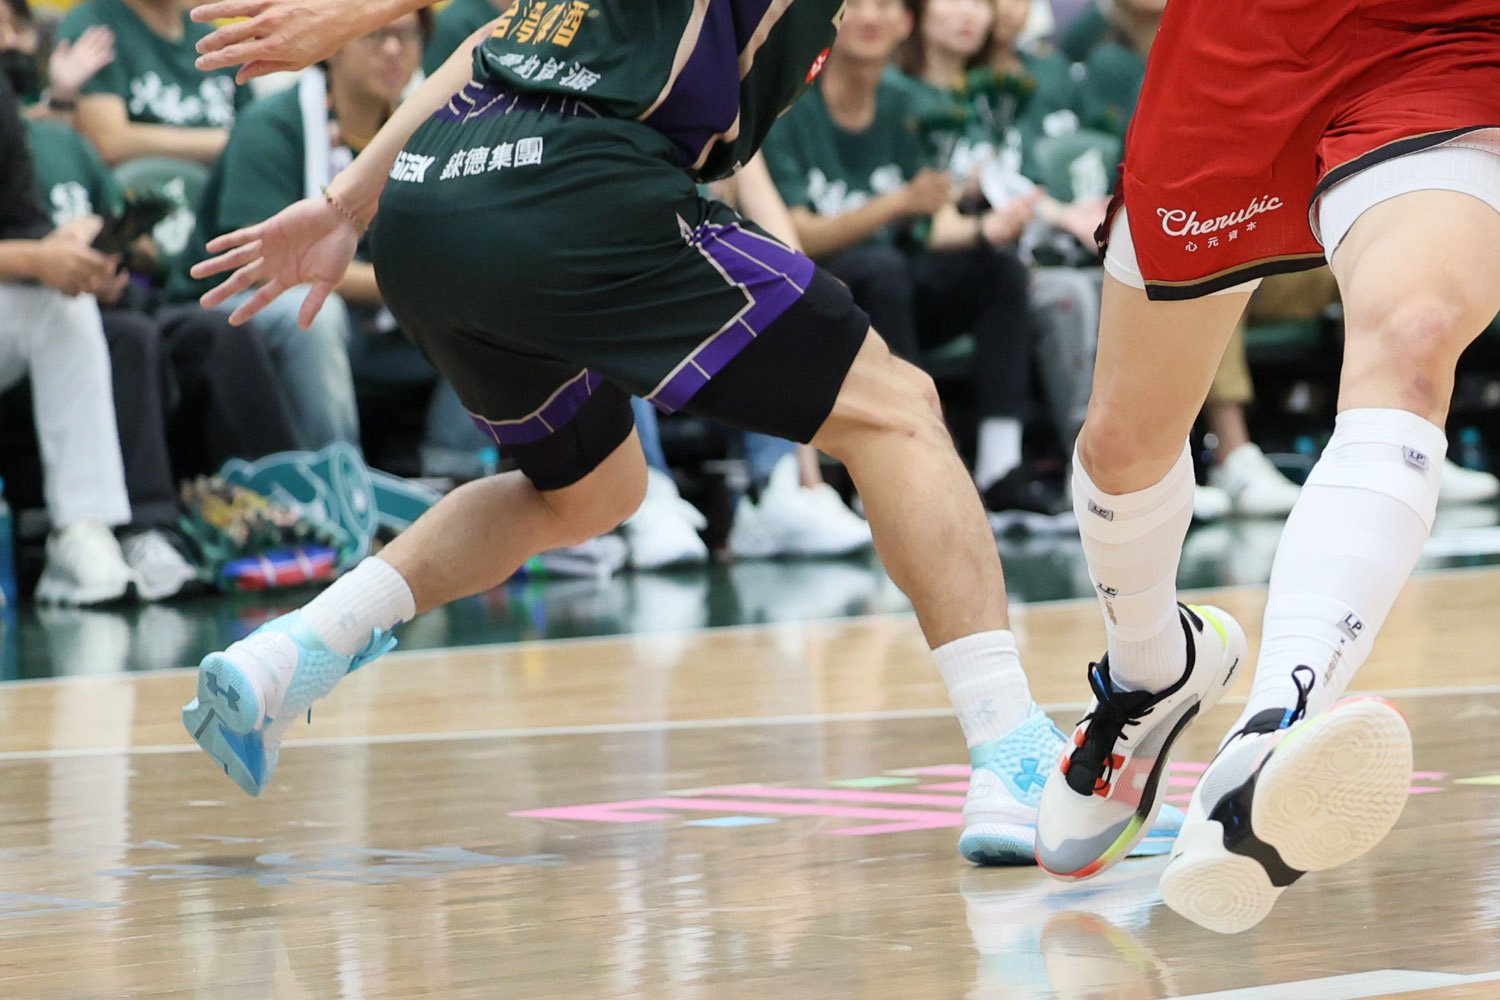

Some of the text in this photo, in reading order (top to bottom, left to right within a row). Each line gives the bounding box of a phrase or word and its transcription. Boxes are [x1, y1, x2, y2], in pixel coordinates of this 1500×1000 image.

[1157, 194, 1283, 237] Cherubic
[1185, 221, 1257, 252] 心元資本
